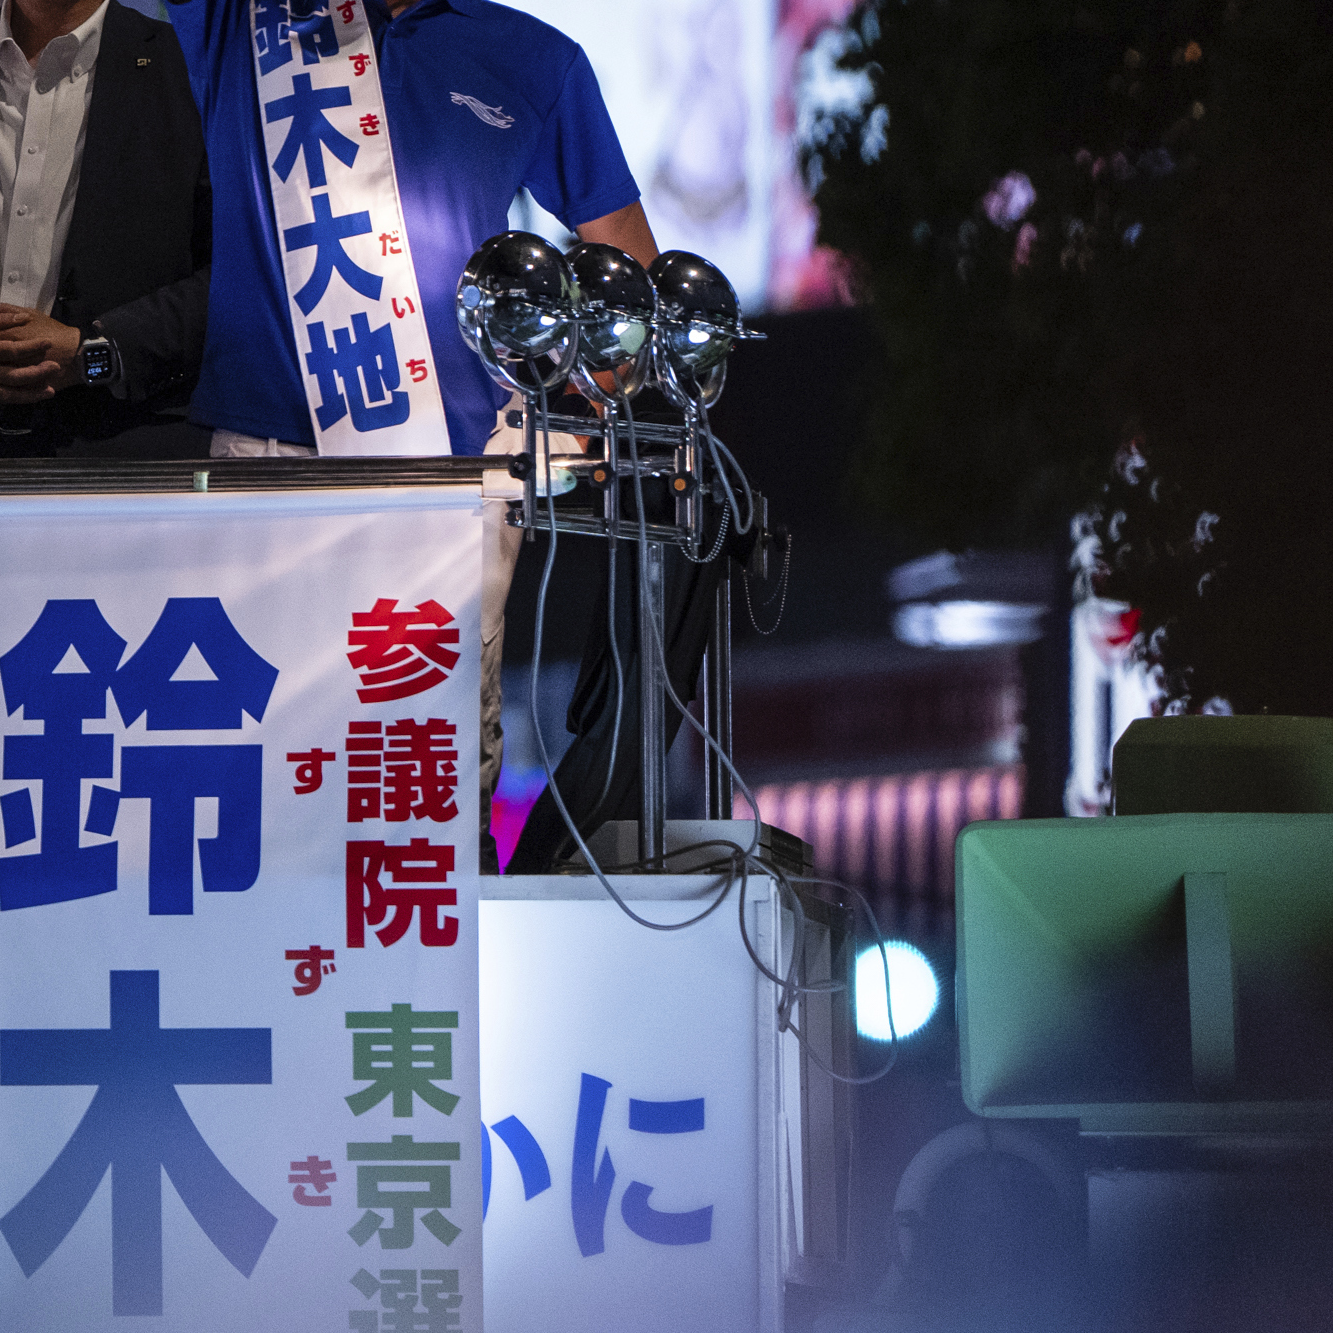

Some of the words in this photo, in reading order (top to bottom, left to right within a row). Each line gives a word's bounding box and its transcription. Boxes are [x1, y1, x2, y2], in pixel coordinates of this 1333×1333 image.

[336, 0, 380, 137] すずき
[380, 231, 429, 383] だいち
[345, 597, 461, 949] 参議院
[284, 747, 338, 1207] すずき
